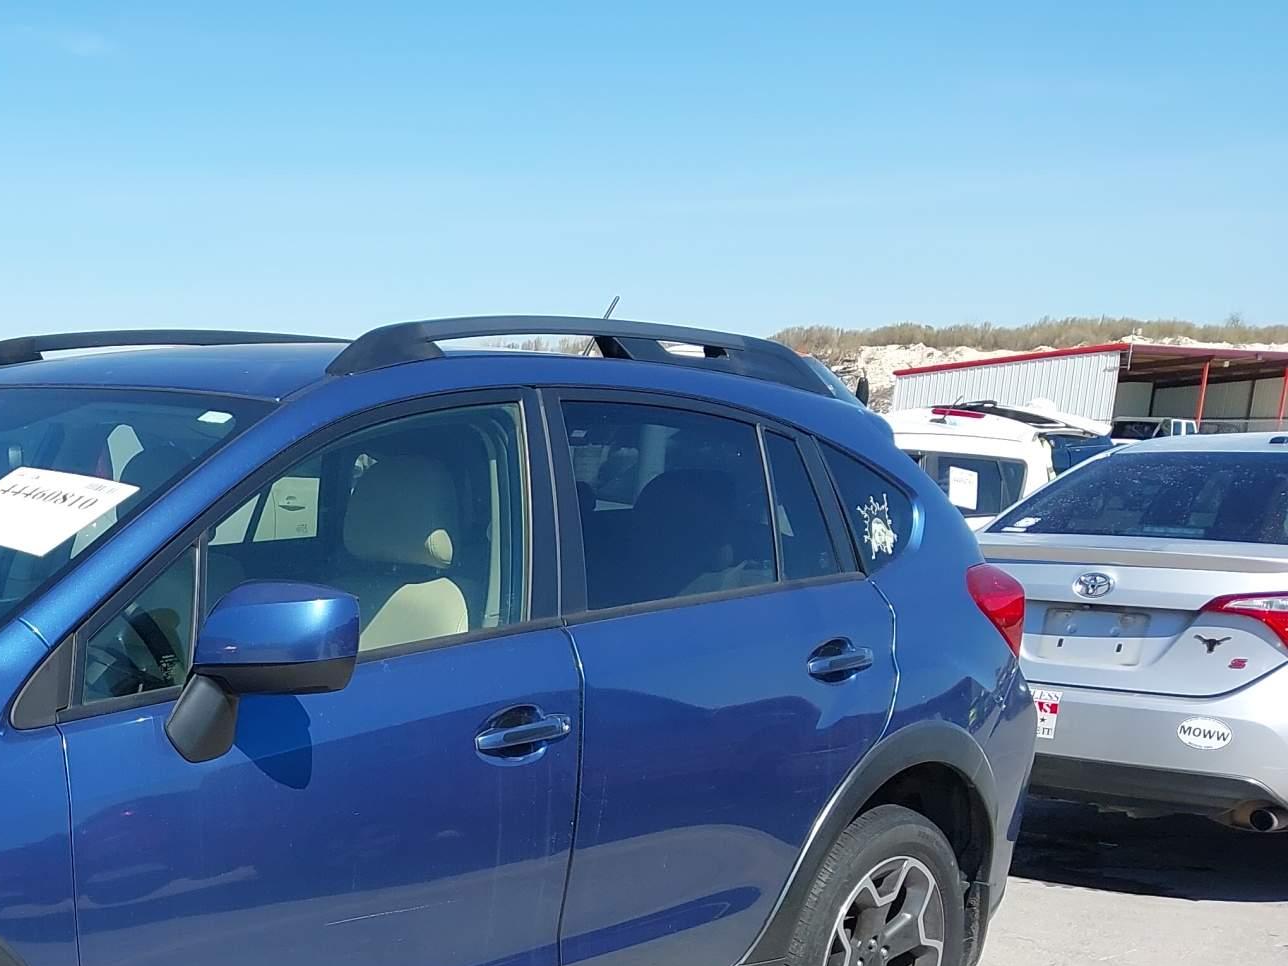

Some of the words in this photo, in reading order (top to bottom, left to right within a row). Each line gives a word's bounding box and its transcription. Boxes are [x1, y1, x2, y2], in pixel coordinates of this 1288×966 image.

[0, 484, 99, 510] 44460810
[1227, 658, 1249, 669] S
[1179, 725, 1230, 742] MOWW
